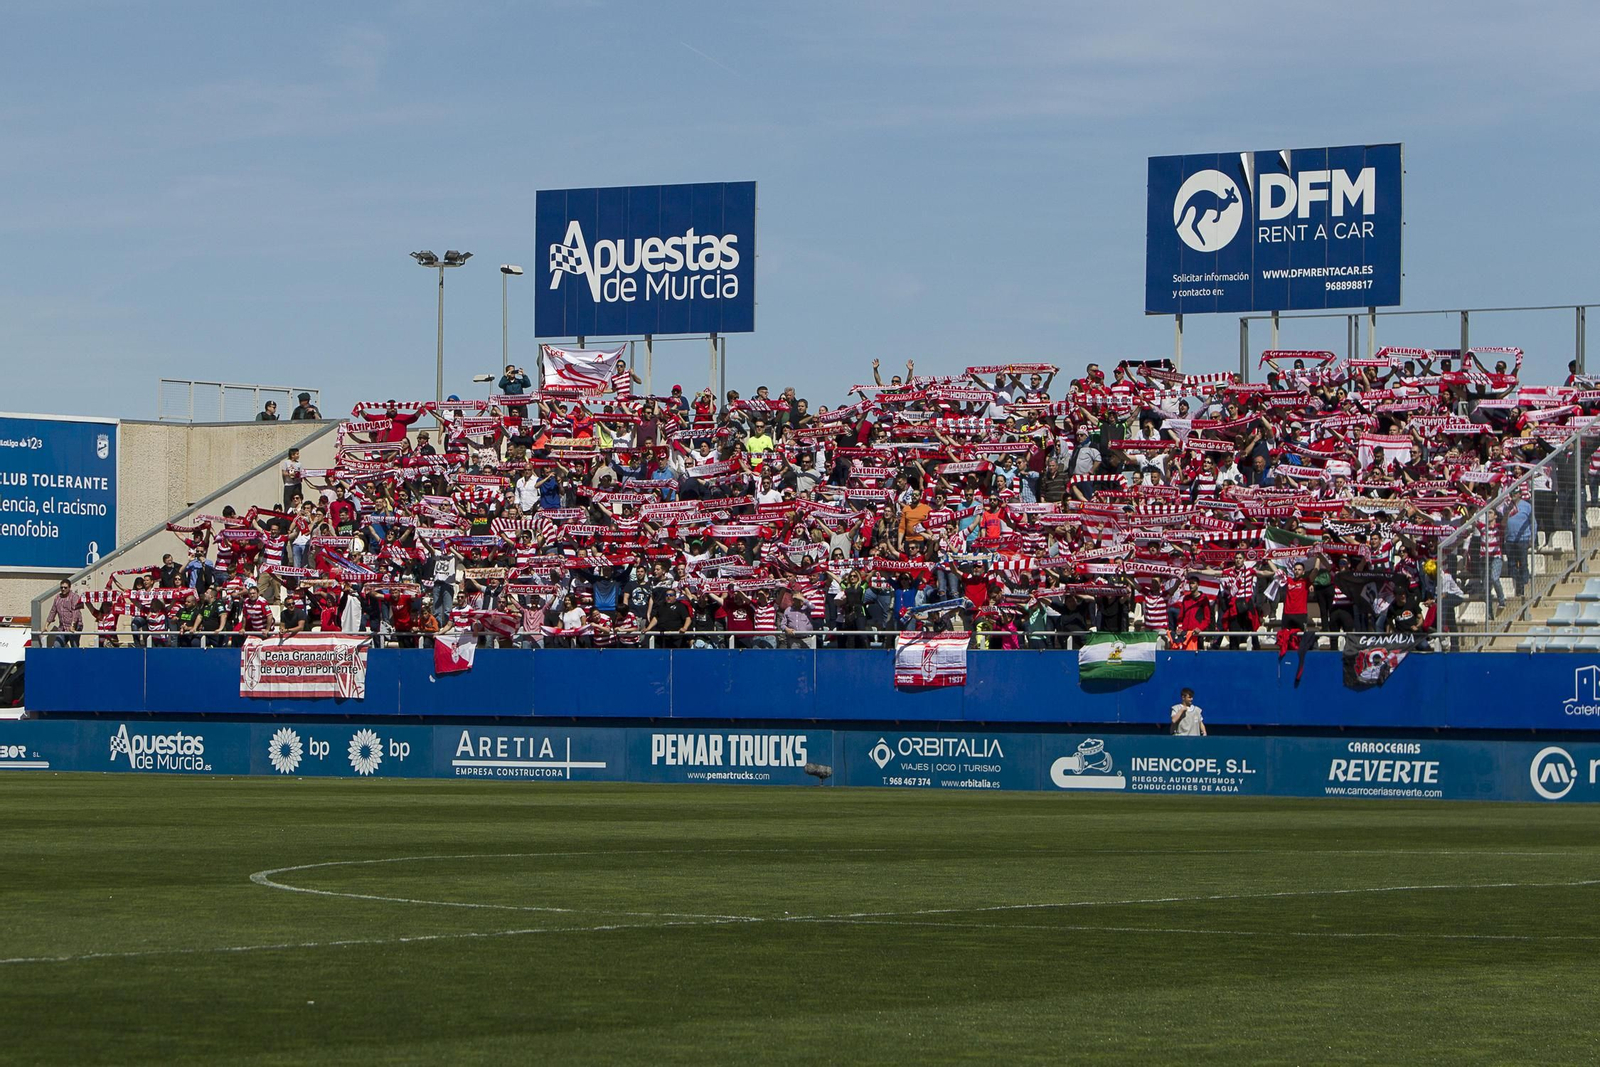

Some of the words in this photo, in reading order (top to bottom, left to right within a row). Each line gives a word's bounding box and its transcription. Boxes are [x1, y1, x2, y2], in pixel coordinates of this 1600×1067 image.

[1259, 168, 1375, 220] DFM
[1259, 225, 1308, 243] RENT
[1314, 224, 1327, 240] A
[1334, 222, 1374, 239] CAR
[550, 221, 739, 302] Apuestas
[1173, 274, 1202, 283] Solicitar
[1204, 272, 1249, 282] información
[1263, 266, 1373, 279] WWW.DFMRENTACAR.ES
[604, 270, 637, 302] de
[646, 270, 738, 300] Murcia
[1326, 280, 1373, 290] 968898817
[1172, 290, 1177, 298] y
[27, 437, 42, 449] 123
[32, 474, 108, 490] TOLERANTE
[43, 497, 54, 513] el
[57, 499, 107, 516] racismo
[1126, 562, 1171, 573] GRANADA
[265, 651, 289, 661] Peña
[292, 651, 353, 662] Granadinista
[260, 666, 272, 674] de
[275, 665, 294, 676] Loja
[298, 667, 303, 675] y
[316, 664, 358, 674] Poniente
[110, 724, 204, 768] Apuestas
[309, 737, 329, 760] bp
[389, 738, 410, 761] bp
[456, 730, 554, 758] ARETIA
[652, 734, 724, 766] PEMAR
[728, 735, 808, 767] TRUCKS
[898, 737, 1004, 759] ORBITALIA
[1348, 742, 1421, 754] CARROCERIAS
[136, 753, 153, 769] de
[900, 762, 928, 771] VIAJES
[936, 764, 956, 772] OCIO
[963, 764, 1001, 773] TURISMO
[1132, 757, 1221, 775] INENCOPE,
[1226, 759, 1256, 773] S.L.
[455, 767, 494, 776] EMPRESA
[496, 768, 563, 777] CONSTRUCTORA
[687, 771, 770, 780] www.pemartrucks.com
[1328, 759, 1439, 784] REVERTE
[889, 777, 903, 786] 968
[904, 777, 917, 786] 467
[918, 778, 931, 787] 374
[941, 778, 1000, 789] www.orbitalia.es
[1325, 786, 1442, 798] www.carroceriasreverte.com
